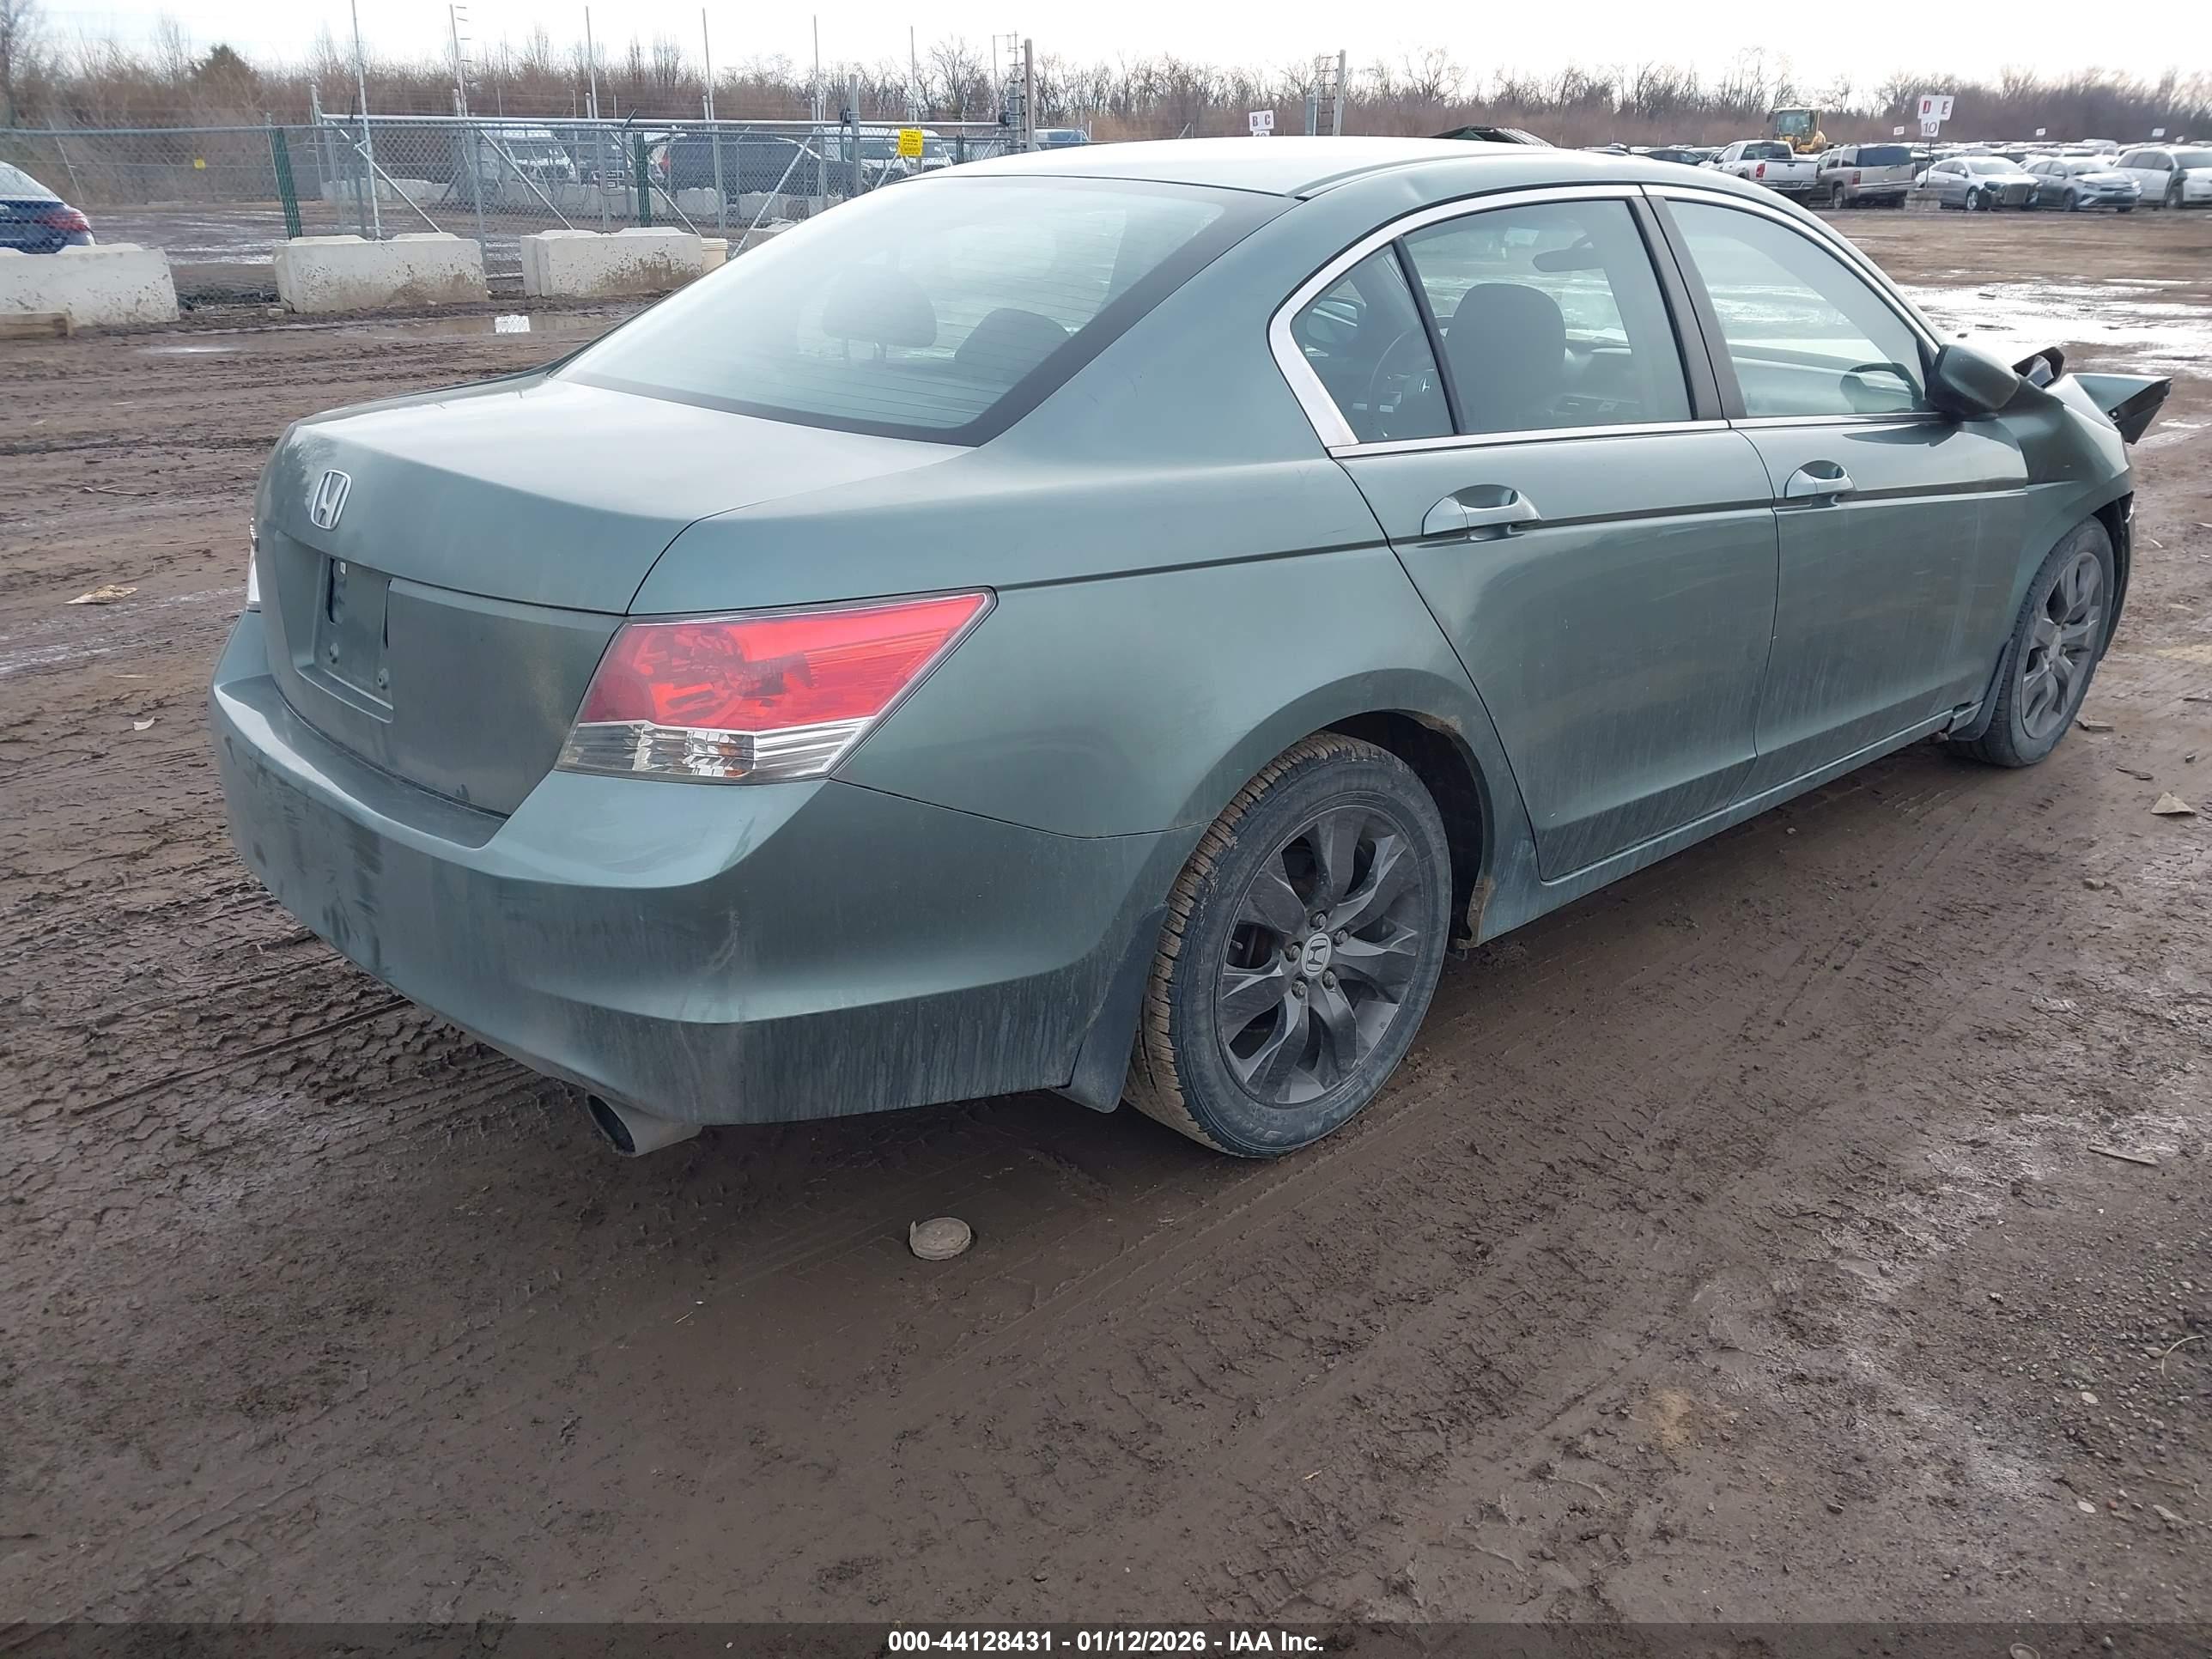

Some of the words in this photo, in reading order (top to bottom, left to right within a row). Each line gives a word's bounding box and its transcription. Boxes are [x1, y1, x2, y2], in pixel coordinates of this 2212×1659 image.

[1923, 100, 1931, 114] D
[1942, 100, 1949, 115] E
[1252, 115, 1259, 127] B
[1264, 113, 1271, 125] C
[1923, 121, 1938, 134] 10
